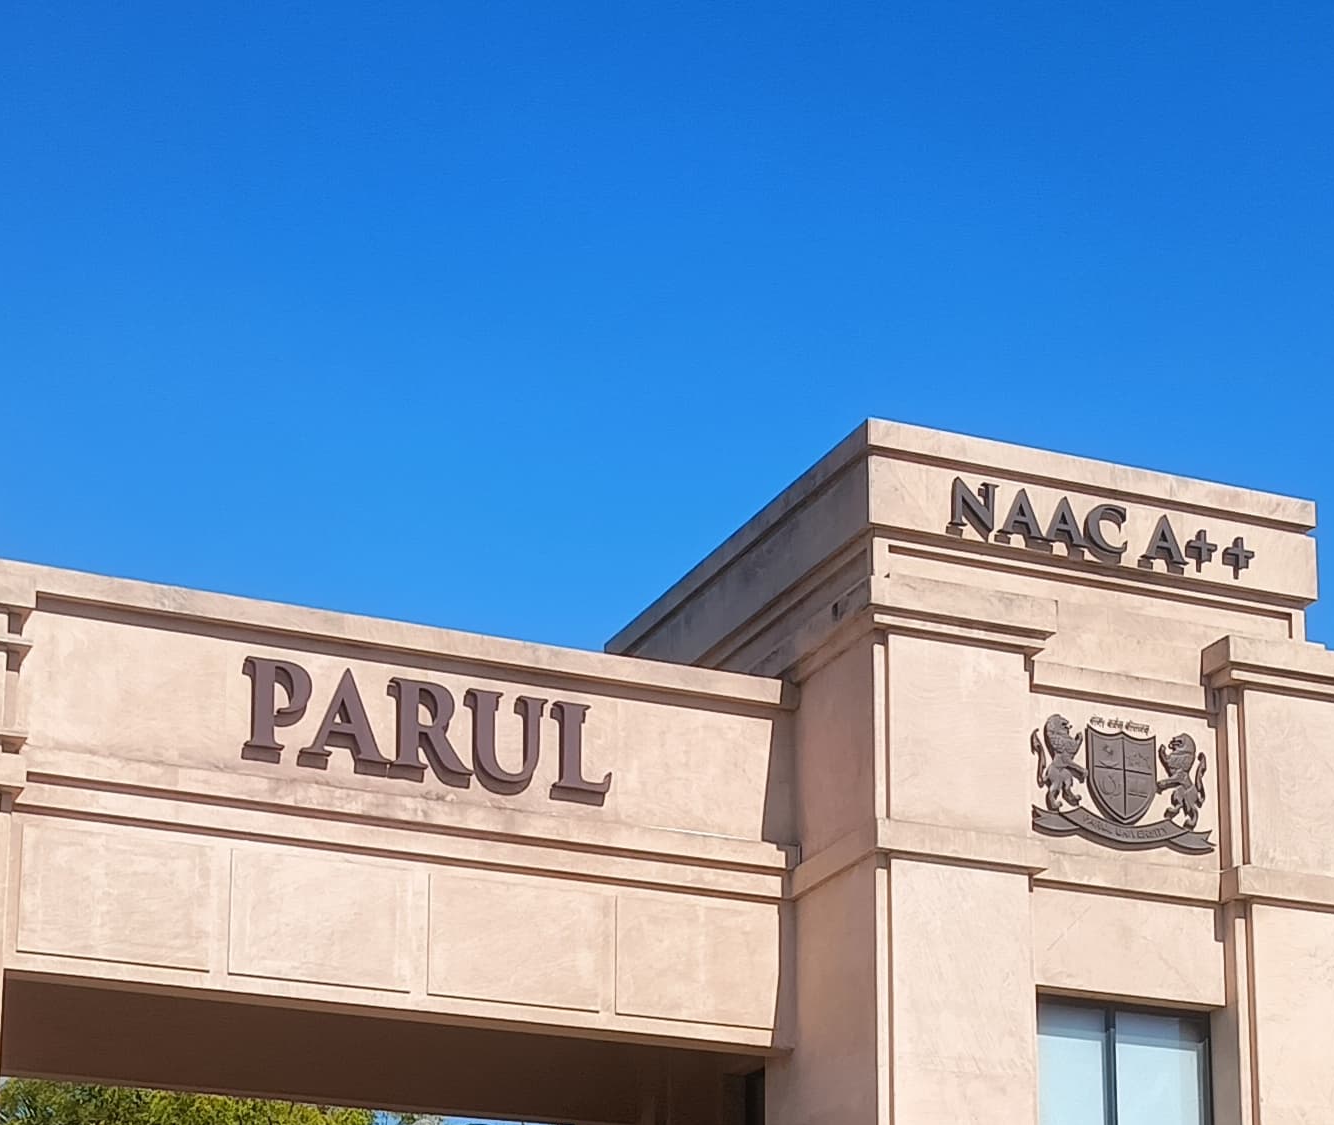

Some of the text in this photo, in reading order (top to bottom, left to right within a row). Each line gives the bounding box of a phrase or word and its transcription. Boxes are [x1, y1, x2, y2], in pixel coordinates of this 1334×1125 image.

[946, 476, 1255, 580] NAAC A++
[241, 655, 612, 807] PARUL
